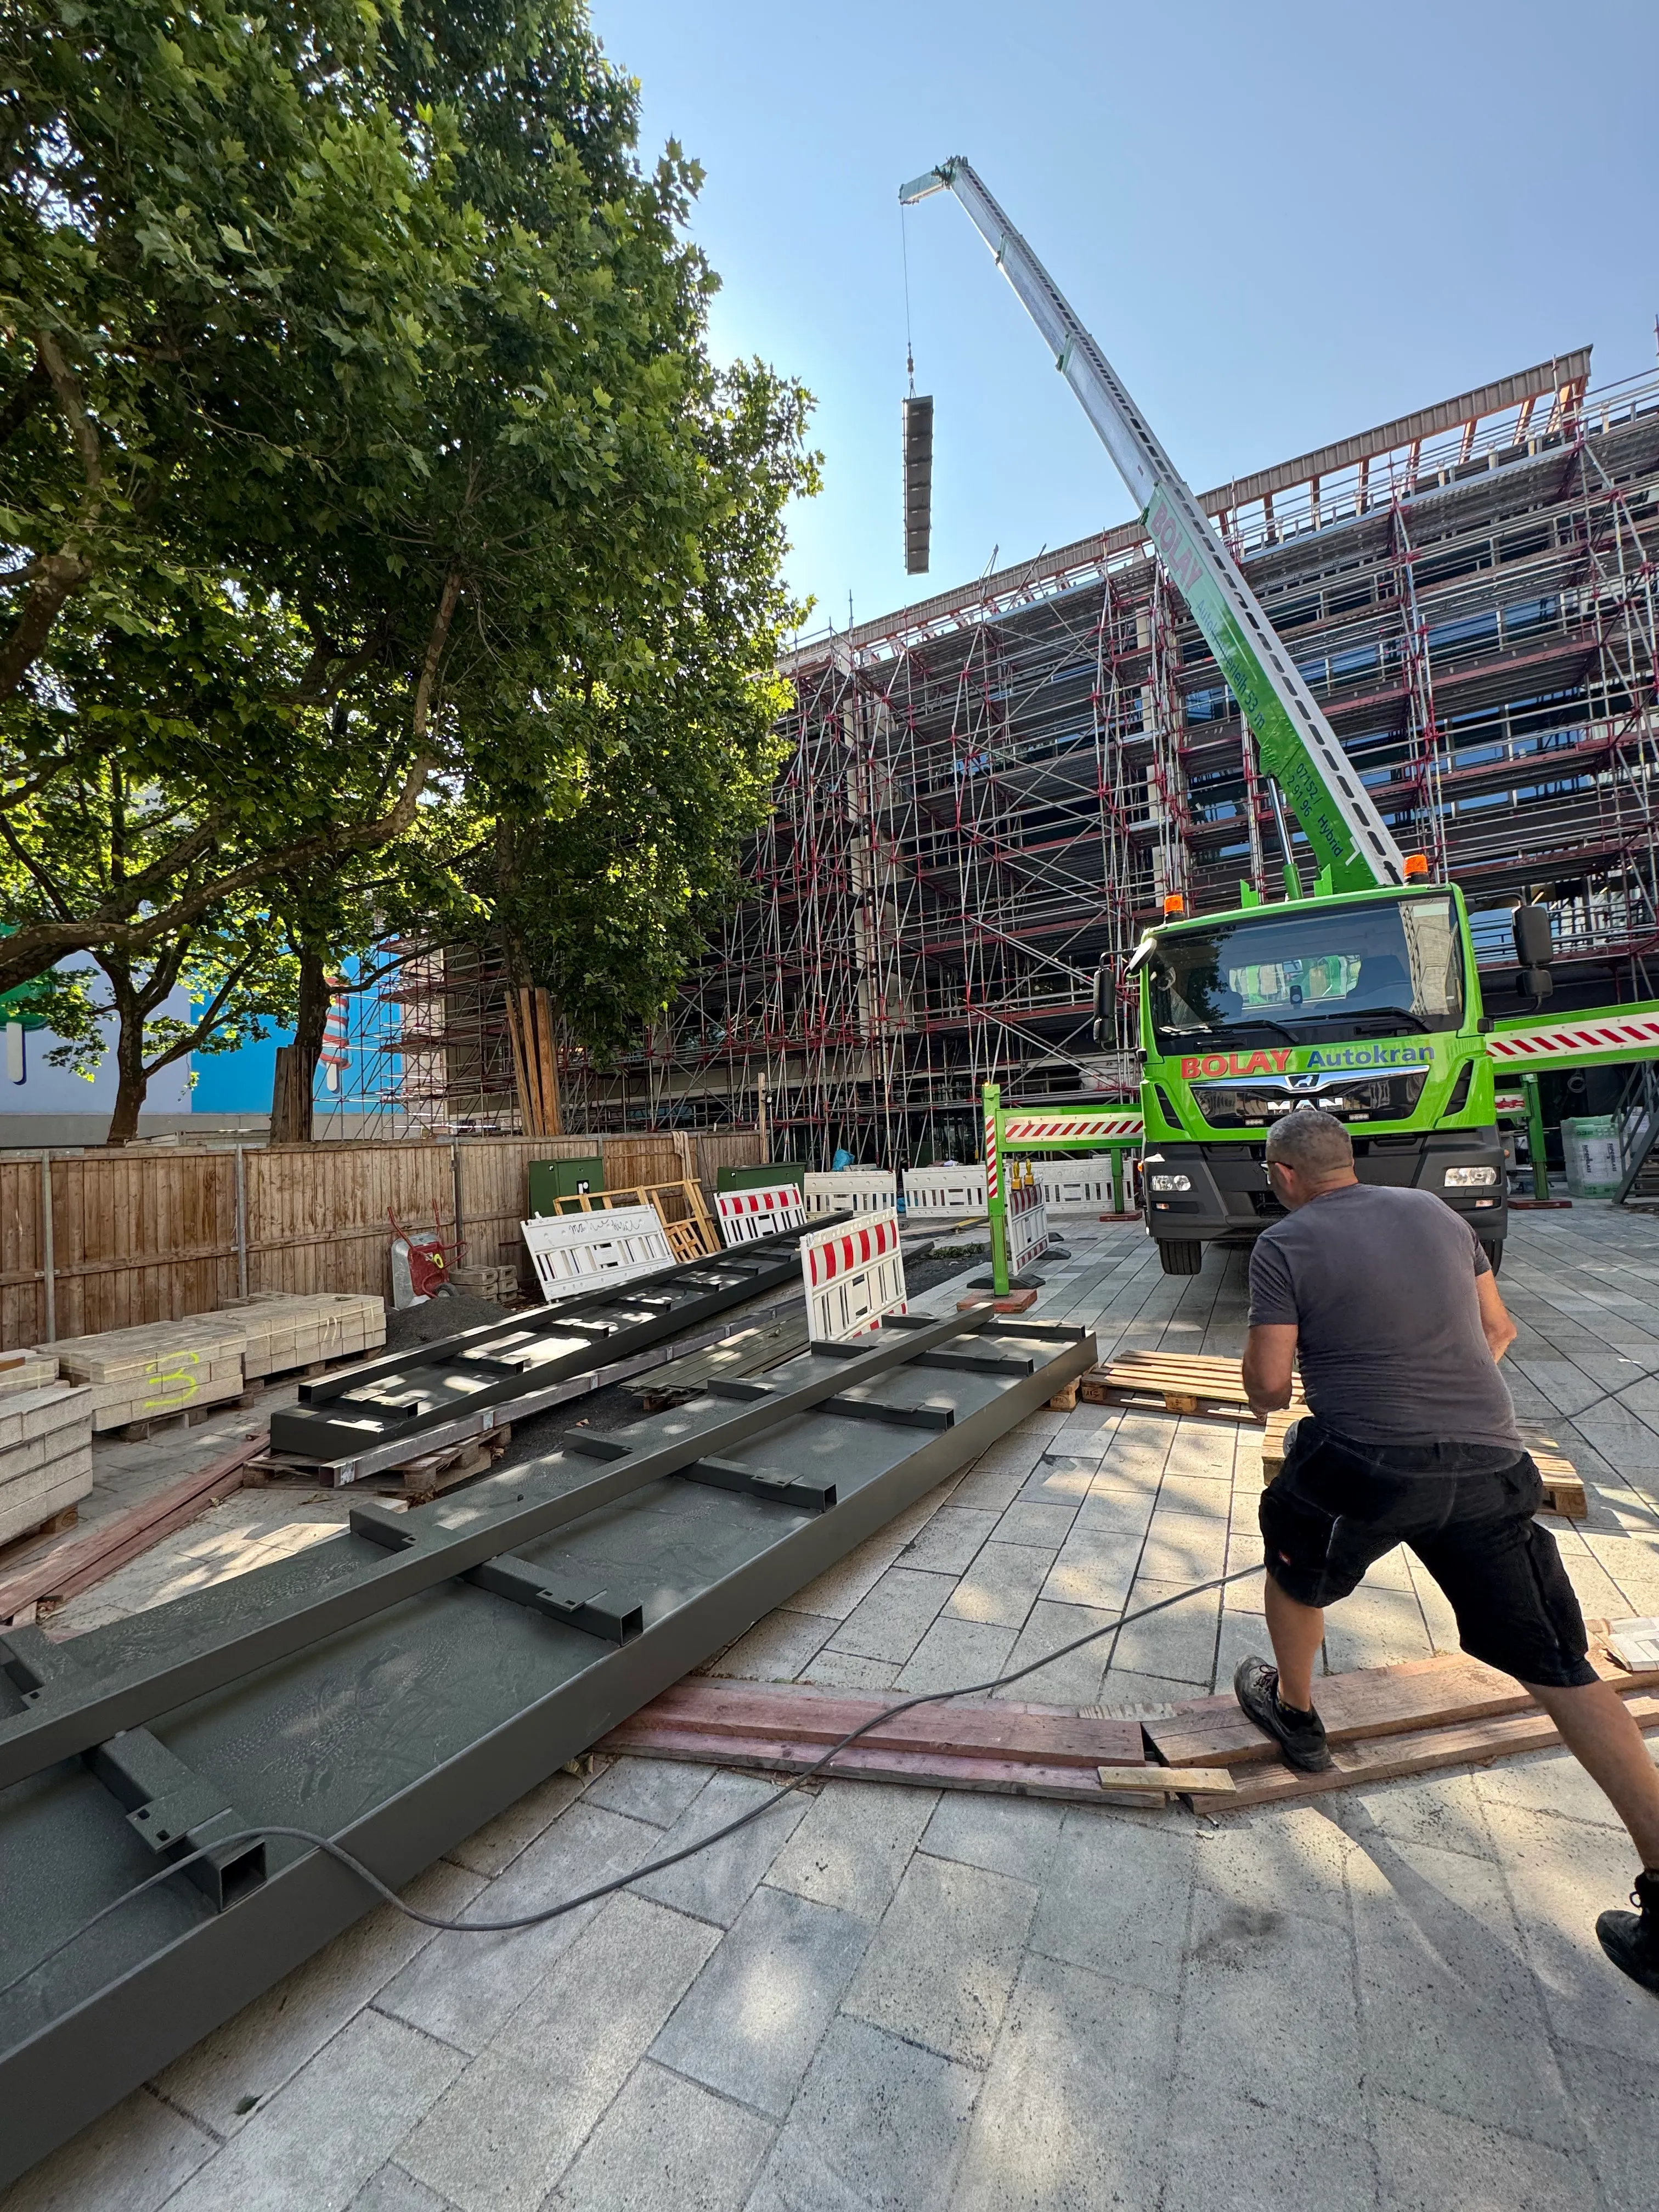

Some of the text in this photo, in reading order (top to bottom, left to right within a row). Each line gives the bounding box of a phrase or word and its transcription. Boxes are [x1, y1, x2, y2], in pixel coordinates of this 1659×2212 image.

[1150, 500, 1203, 594] BOLAY
[1244, 690, 1258, 713] 53
[1254, 712, 1265, 730] m
[1287, 775, 1312, 817] 2 91 96
[1318, 814, 1344, 857] Hybrid
[1181, 1045, 1435, 1079] BOLAY Autokran
[1267, 1097, 1343, 1115] MAN
[145, 1351, 200, 1408] 3
